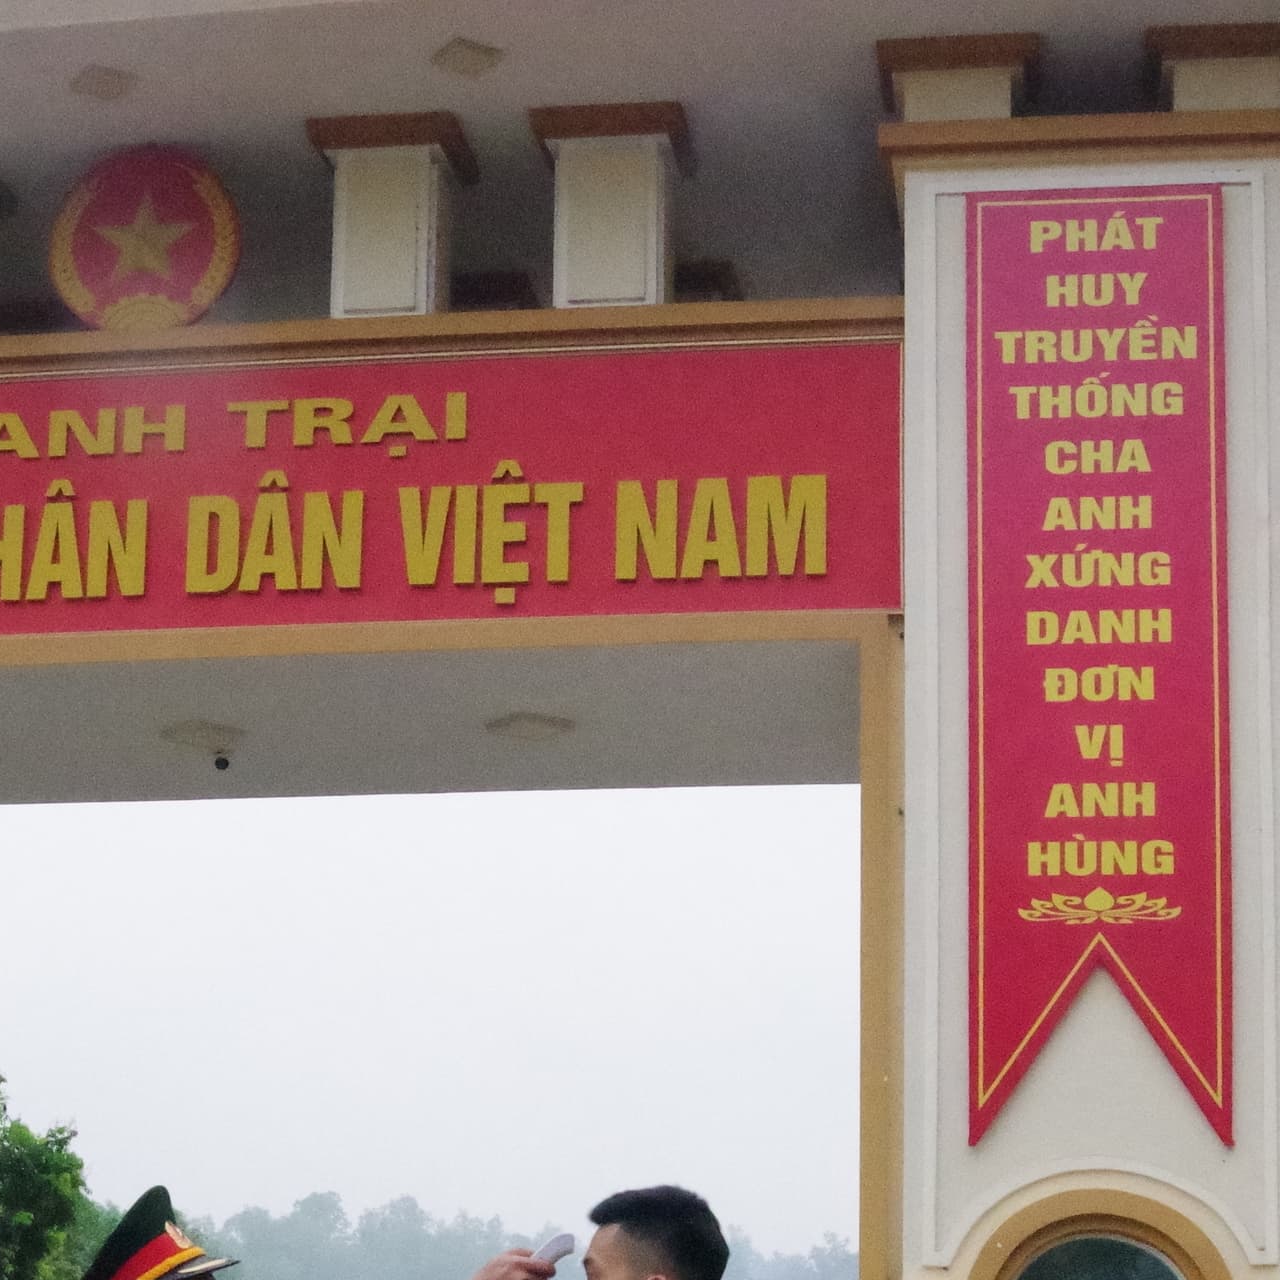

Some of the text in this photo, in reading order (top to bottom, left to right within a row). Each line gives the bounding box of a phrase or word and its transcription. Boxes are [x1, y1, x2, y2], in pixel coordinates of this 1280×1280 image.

[1030, 211, 1163, 253] PHÁT
[1047, 273, 1146, 306] HUY
[994, 316, 1197, 363] TRUYỀN
[1009, 373, 1183, 419] THỐNG
[227, 392, 466, 456] TRẠI
[1045, 440, 1151, 474] CHA
[186, 470, 363, 592] DÂN
[399, 460, 583, 603] VIỆT
[615, 475, 826, 579] NAM
[1043, 496, 1151, 530] ANH
[1026, 544, 1170, 588] XỨNG
[1027, 609, 1171, 644] DANH
[1044, 665, 1154, 701] ĐƠN
[1075, 725, 1123, 766] VỊ
[1045, 783, 1155, 817] ANH
[1028, 835, 1173, 876] HÙNG
